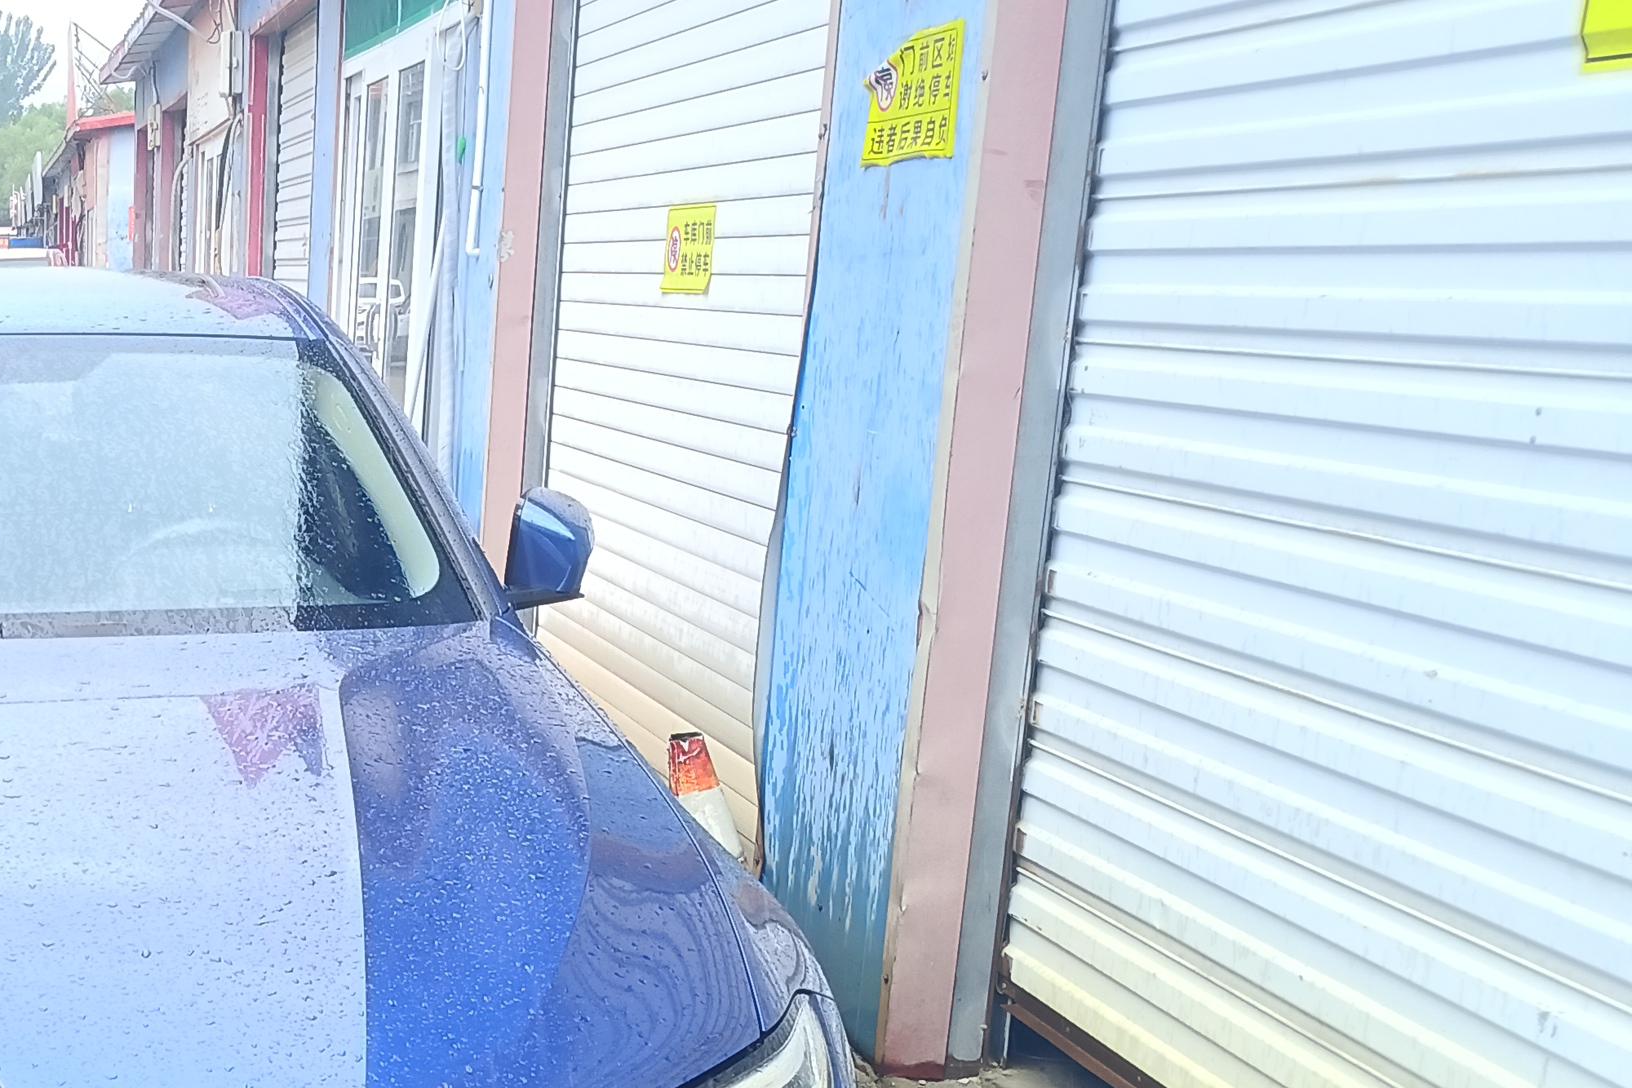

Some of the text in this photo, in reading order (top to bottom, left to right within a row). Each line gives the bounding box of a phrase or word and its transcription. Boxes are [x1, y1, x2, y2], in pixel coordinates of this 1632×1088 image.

[868, 115, 947, 155] 违者后果自负
[684, 220, 712, 245] 车库门前
[680, 251, 709, 277] 禁止停车
